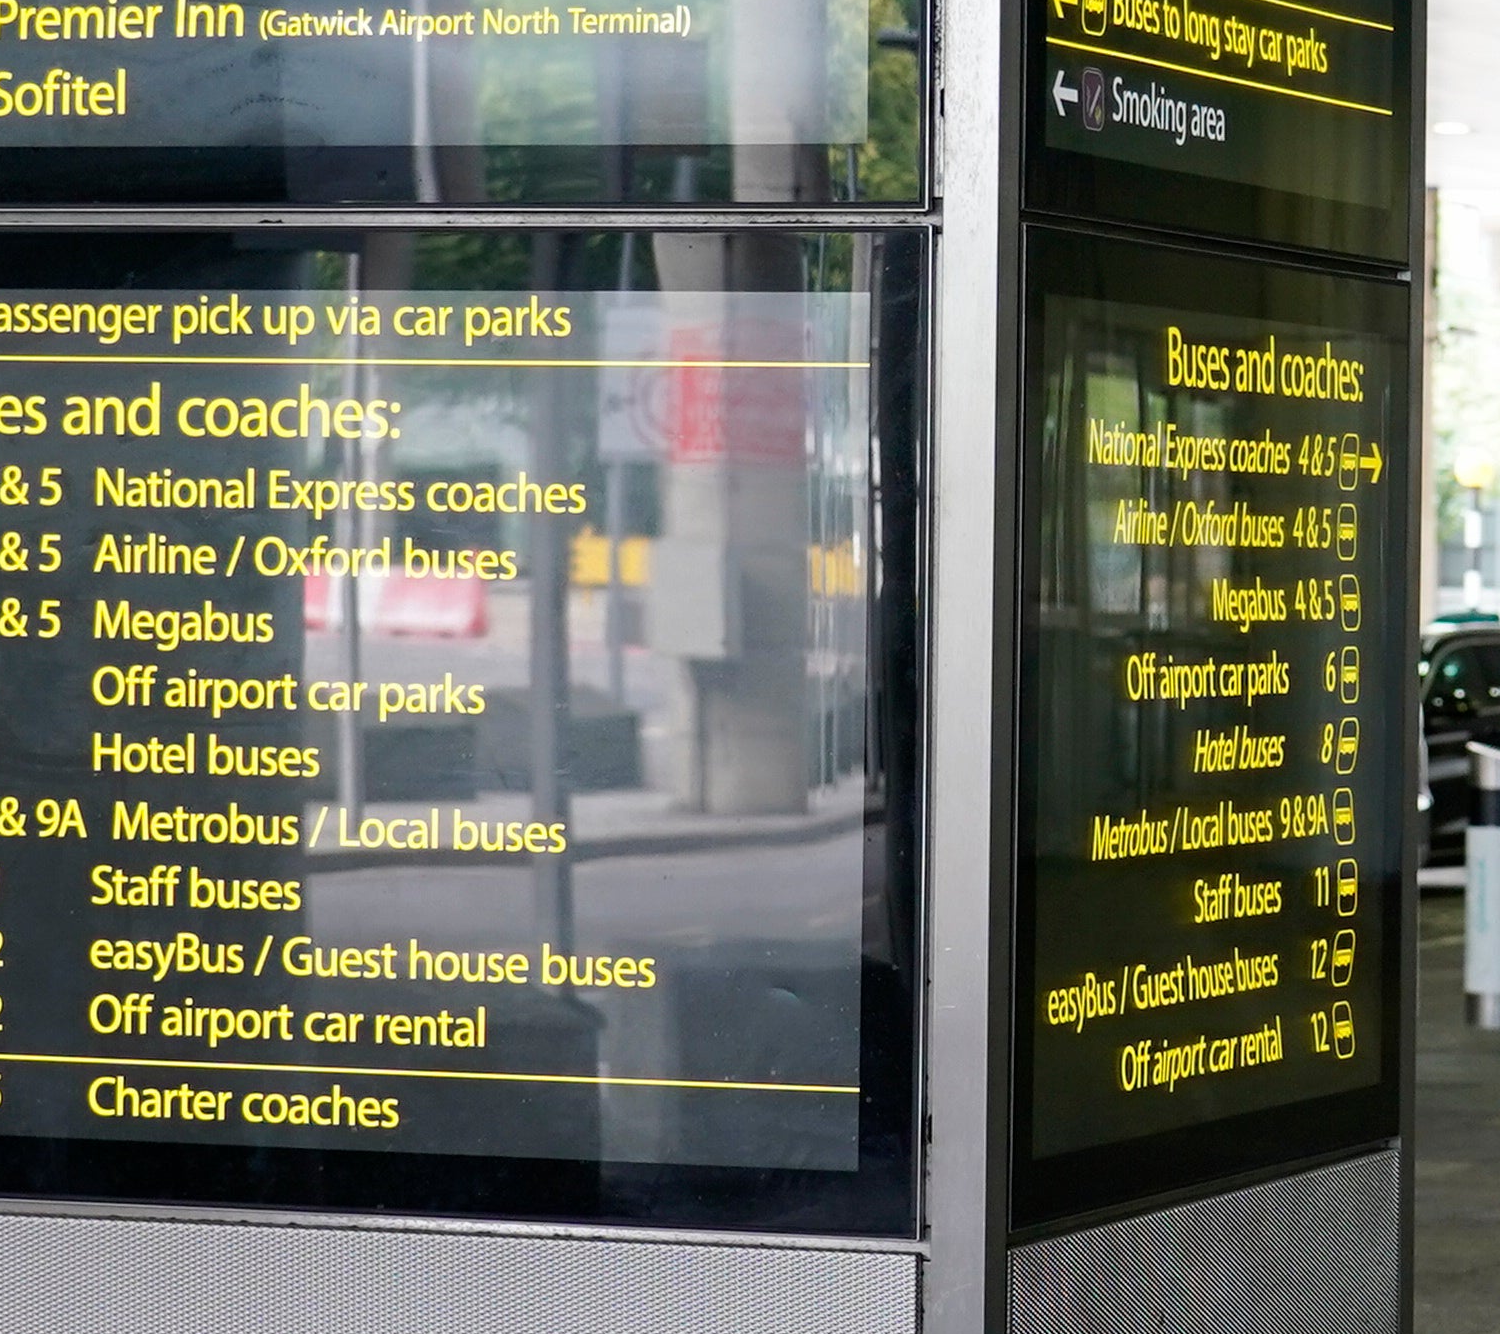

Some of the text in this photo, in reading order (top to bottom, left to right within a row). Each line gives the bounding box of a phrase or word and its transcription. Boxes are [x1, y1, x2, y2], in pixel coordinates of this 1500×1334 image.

[259, 8, 374, 40] (Gatwick
[379, 7, 475, 42] Airport
[482, 7, 560, 36] North
[567, 4, 691, 37] Terminal)
[1223, 15, 1256, 68] stay
[1258, 28, 1284, 63] car
[1285, 28, 1328, 76] parks
[1112, 76, 1226, 146] Smoking area
[171, 294, 252, 343] pick
[262, 305, 316, 345] up
[324, 305, 381, 336] via
[392, 305, 452, 337] car
[463, 295, 571, 345] parks
[1167, 326, 1365, 402] Buses and coaches:
[60, 381, 161, 437] and
[176, 384, 401, 439] coaches:
[1086, 420, 1291, 481] National Express coaches
[39, 466, 63, 507] 5
[94, 467, 255, 509] National
[267, 468, 416, 520] Express
[425, 475, 587, 514] coaches
[1112, 497, 1285, 548] Airline / Oxford buses
[39, 532, 62, 573] 5
[92, 533, 217, 576] Airline
[225, 536, 245, 575] /
[252, 534, 391, 576] Oxford
[402, 538, 517, 580] buses
[37, 599, 62, 639] 5
[93, 600, 274, 652] Megabus
[1212, 577, 1288, 634] Megabus
[91, 664, 157, 707] Off
[163, 675, 296, 718] airport
[305, 682, 365, 712] car
[377, 676, 486, 720] parks
[1126, 650, 1290, 708] Off airport car parks
[92, 732, 196, 775] Hotel
[207, 734, 320, 778] buses
[35, 798, 87, 838] 9A
[112, 800, 300, 845] Metrobus
[307, 805, 328, 848] /
[337, 808, 439, 850] Local
[452, 812, 566, 854] buses
[1091, 801, 1274, 861] Metrobus / Local buses
[90, 864, 180, 907] Staff
[189, 867, 302, 912] buses
[1193, 874, 1282, 924] Staff buses
[89, 931, 245, 982] easyBus
[253, 935, 273, 976] /
[281, 935, 396, 979] Guest
[407, 939, 529, 985] house
[540, 944, 656, 989] buses
[1047, 948, 1279, 1033] easyBus / Guest house buses
[88, 992, 153, 1035] Off
[160, 999, 293, 1048] airport
[303, 1011, 364, 1043] car
[374, 1007, 486, 1048] rental
[1121, 1016, 1283, 1092] Off airport car rental
[87, 1076, 232, 1121] Charter
[241, 1085, 400, 1129] coaches
